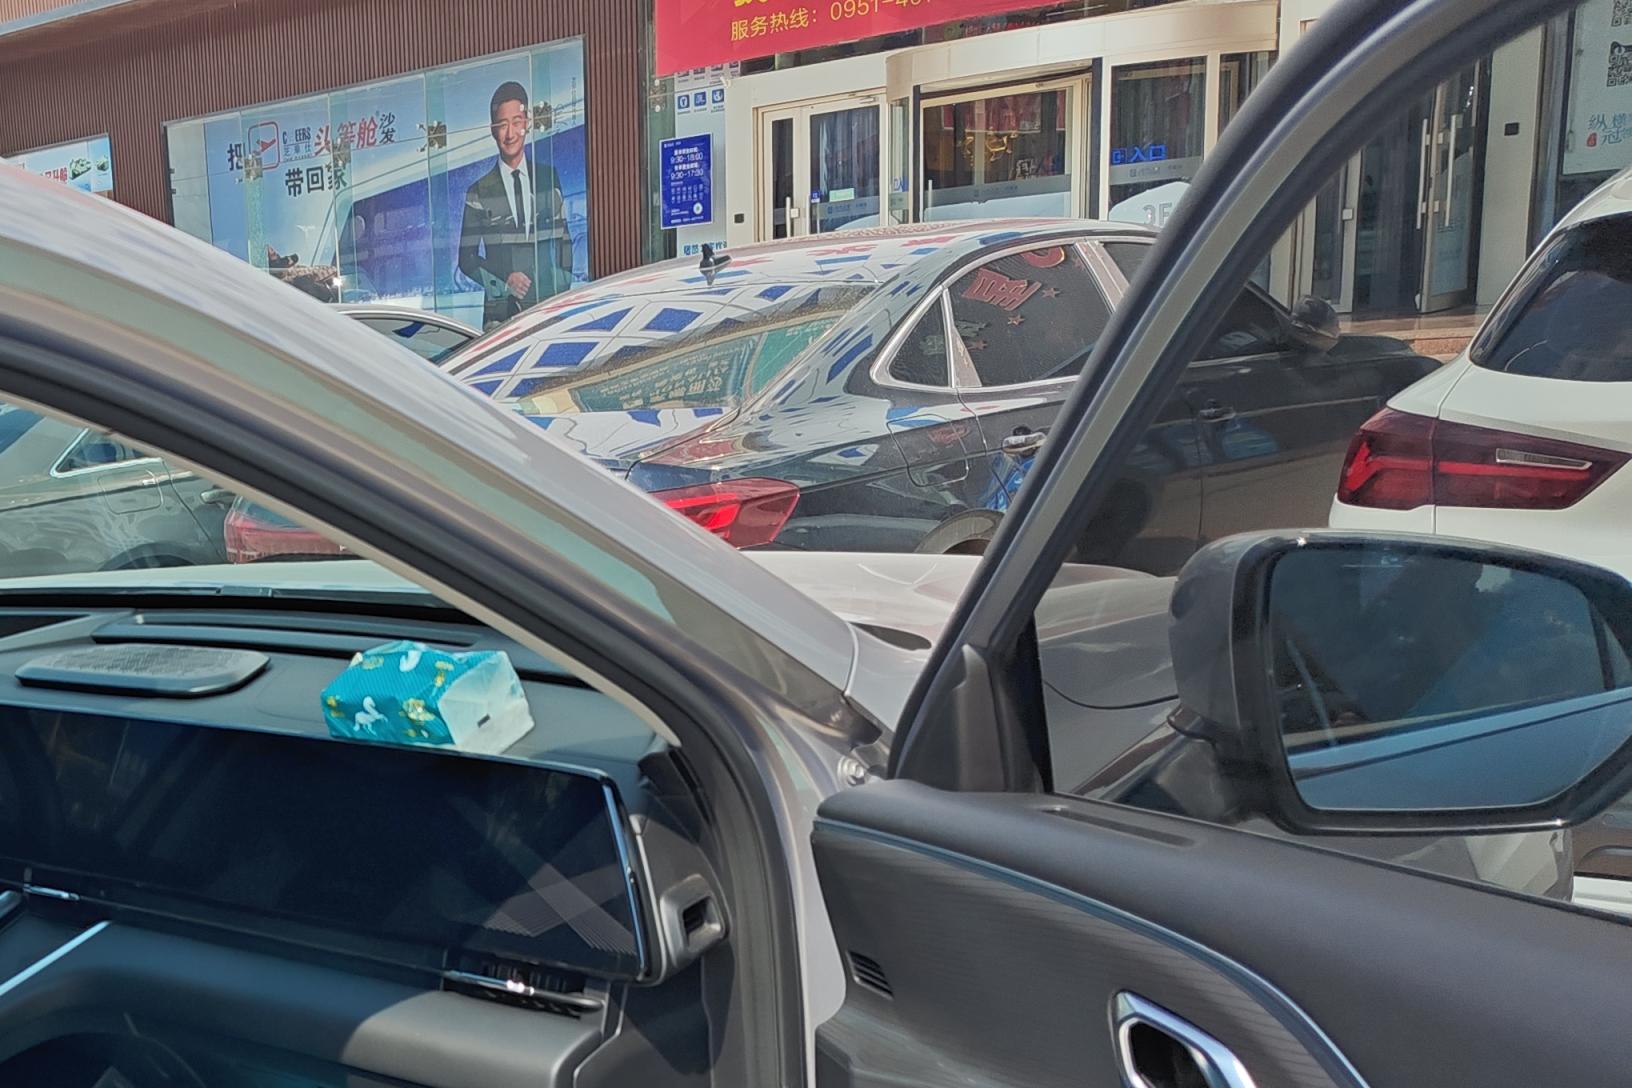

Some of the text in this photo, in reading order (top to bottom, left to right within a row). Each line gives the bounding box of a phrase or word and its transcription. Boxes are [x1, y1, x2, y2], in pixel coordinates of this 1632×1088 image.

[731, 7, 816, 41] 服务热线：
[1129, 144, 1168, 163] 入口
